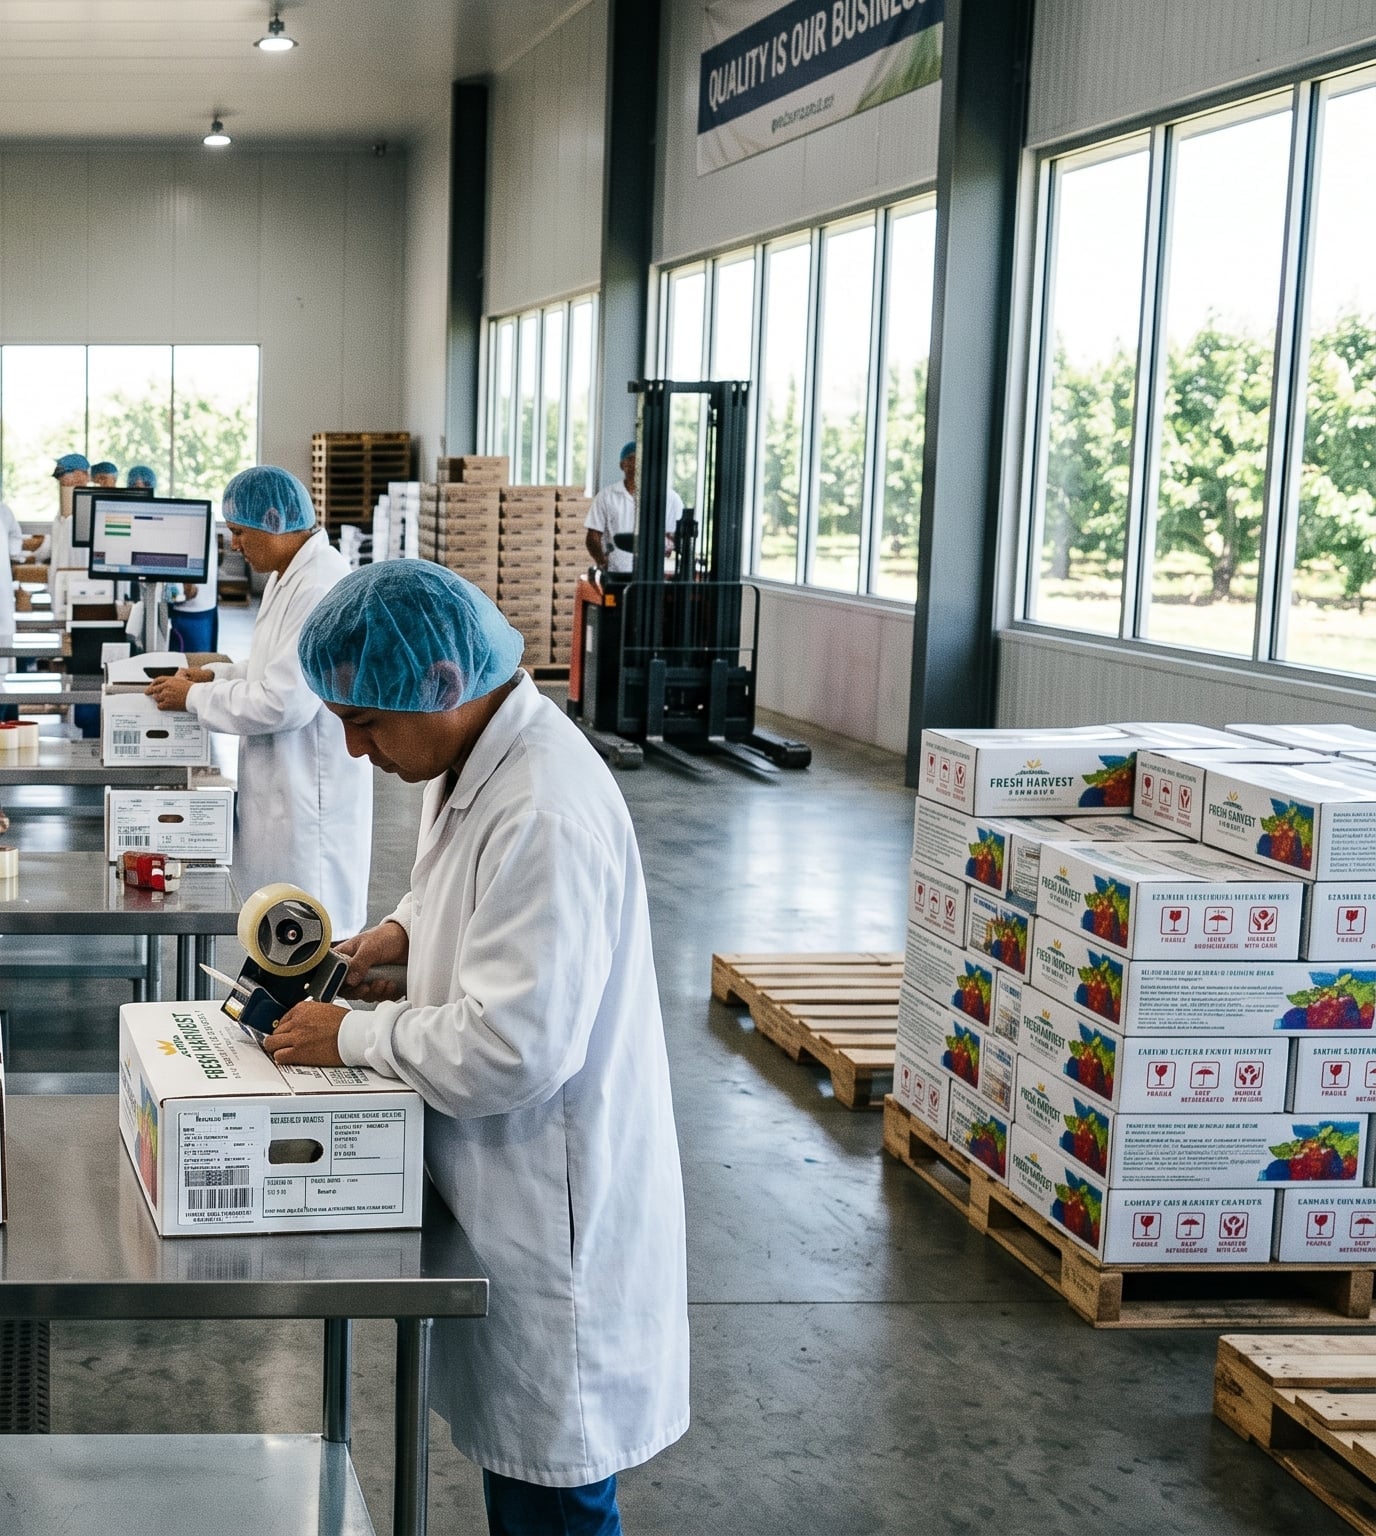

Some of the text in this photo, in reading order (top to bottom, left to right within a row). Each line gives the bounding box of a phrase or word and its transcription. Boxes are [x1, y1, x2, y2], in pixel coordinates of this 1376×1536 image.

[708, 42, 769, 112] QUALITY
[771, 32, 788, 78] IS
[790, 10, 827, 68] OUR
[990, 776, 1074, 788] FRESH HARVEST
[194, 1053, 228, 1079] FRESH
